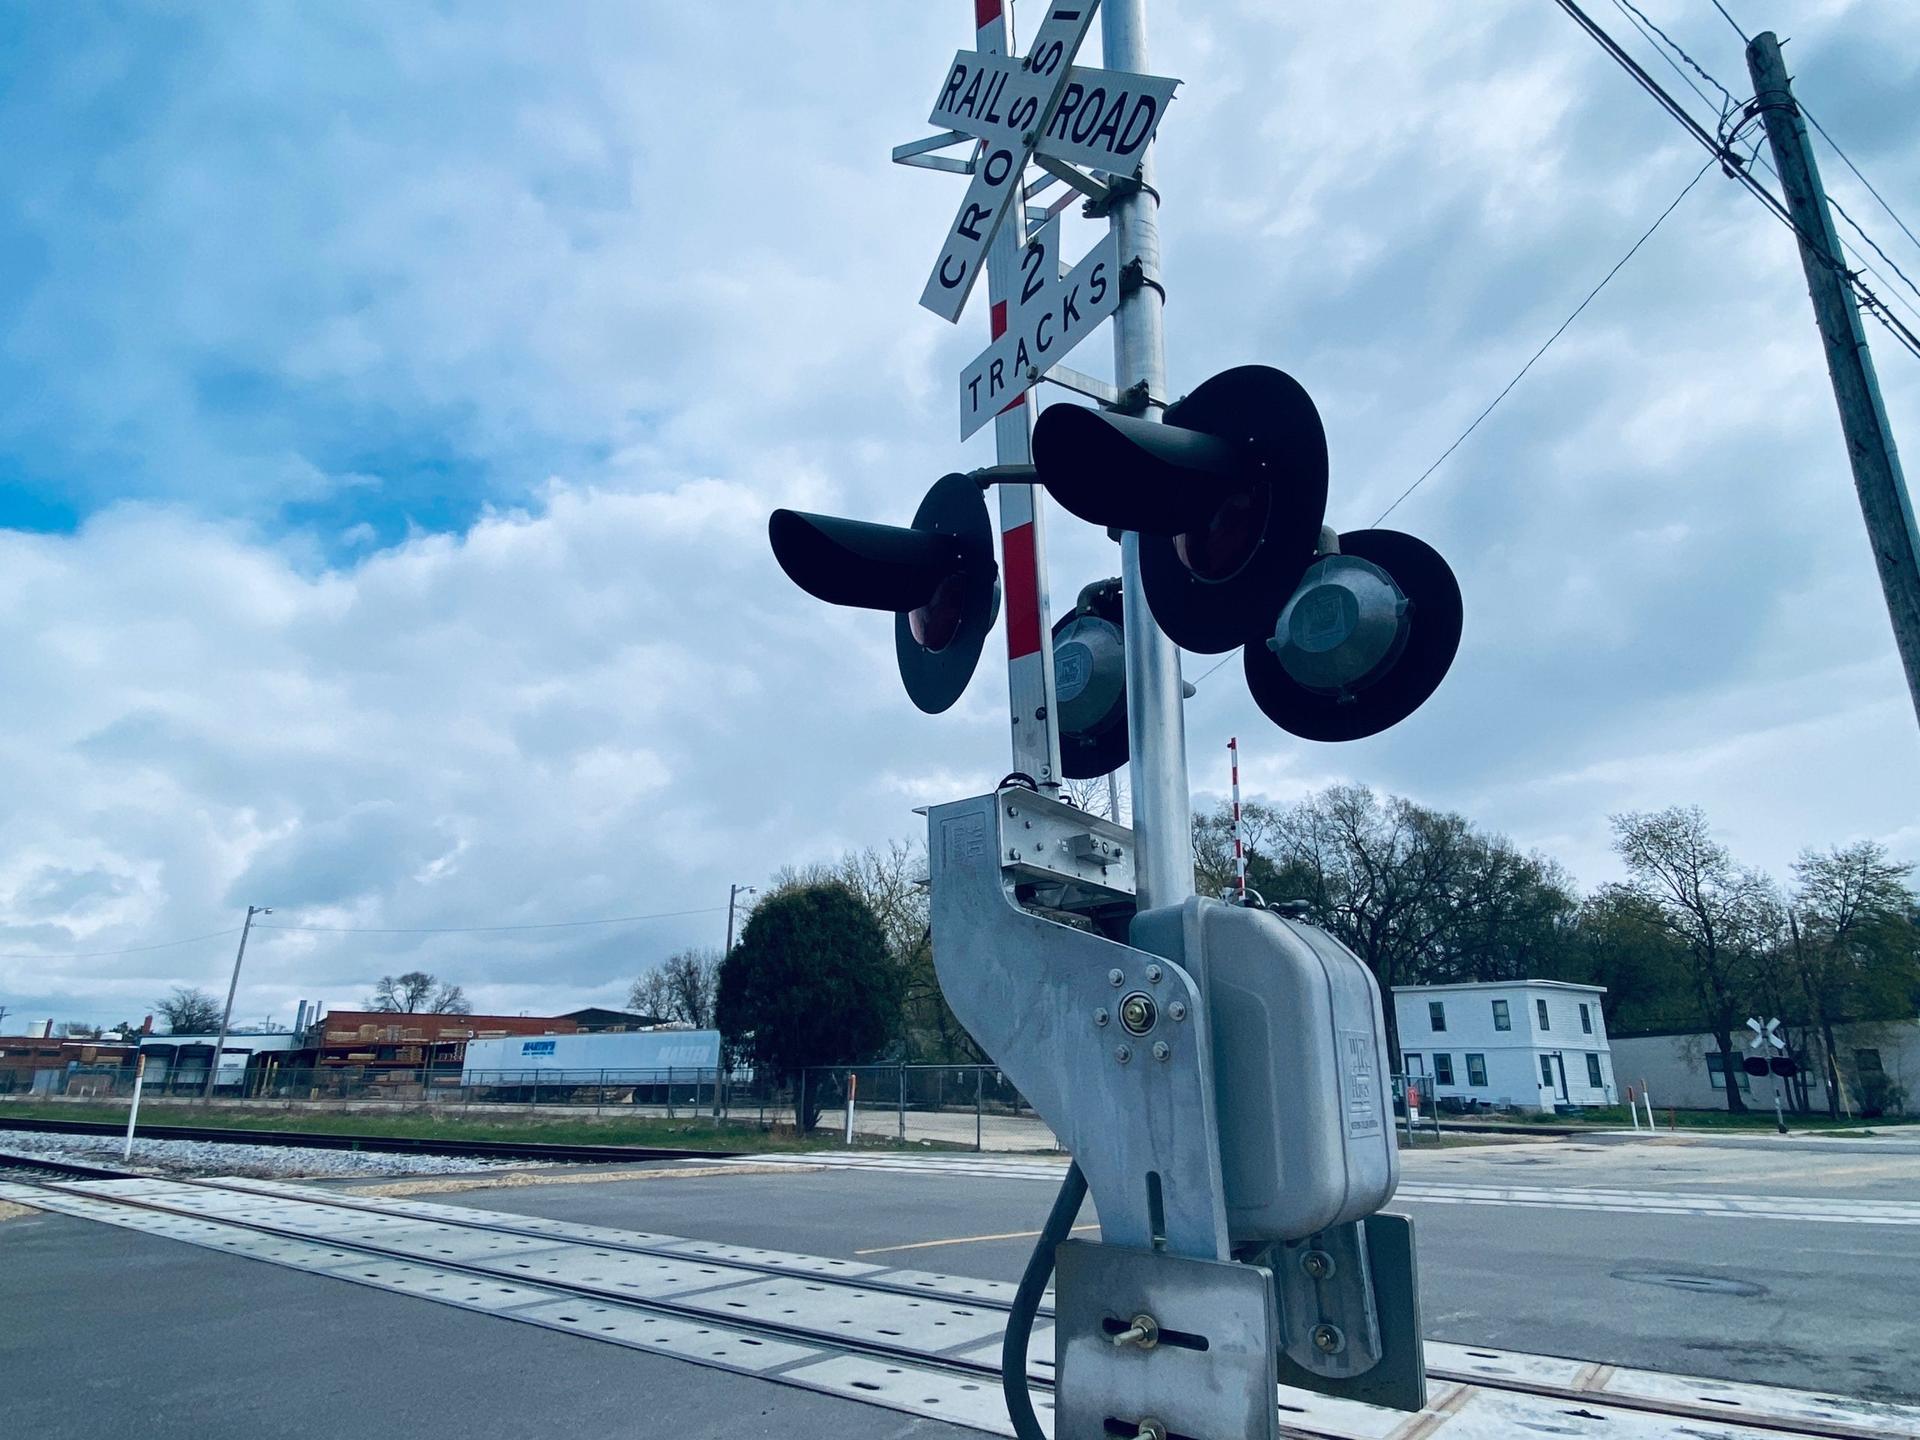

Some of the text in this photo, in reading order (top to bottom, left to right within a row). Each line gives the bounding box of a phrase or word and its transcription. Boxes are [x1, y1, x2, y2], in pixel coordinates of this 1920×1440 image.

[938, 64, 1156, 156] RAIL ROAD
[1020, 243, 1045, 306] 2
[967, 262, 1107, 413] TRACKS
